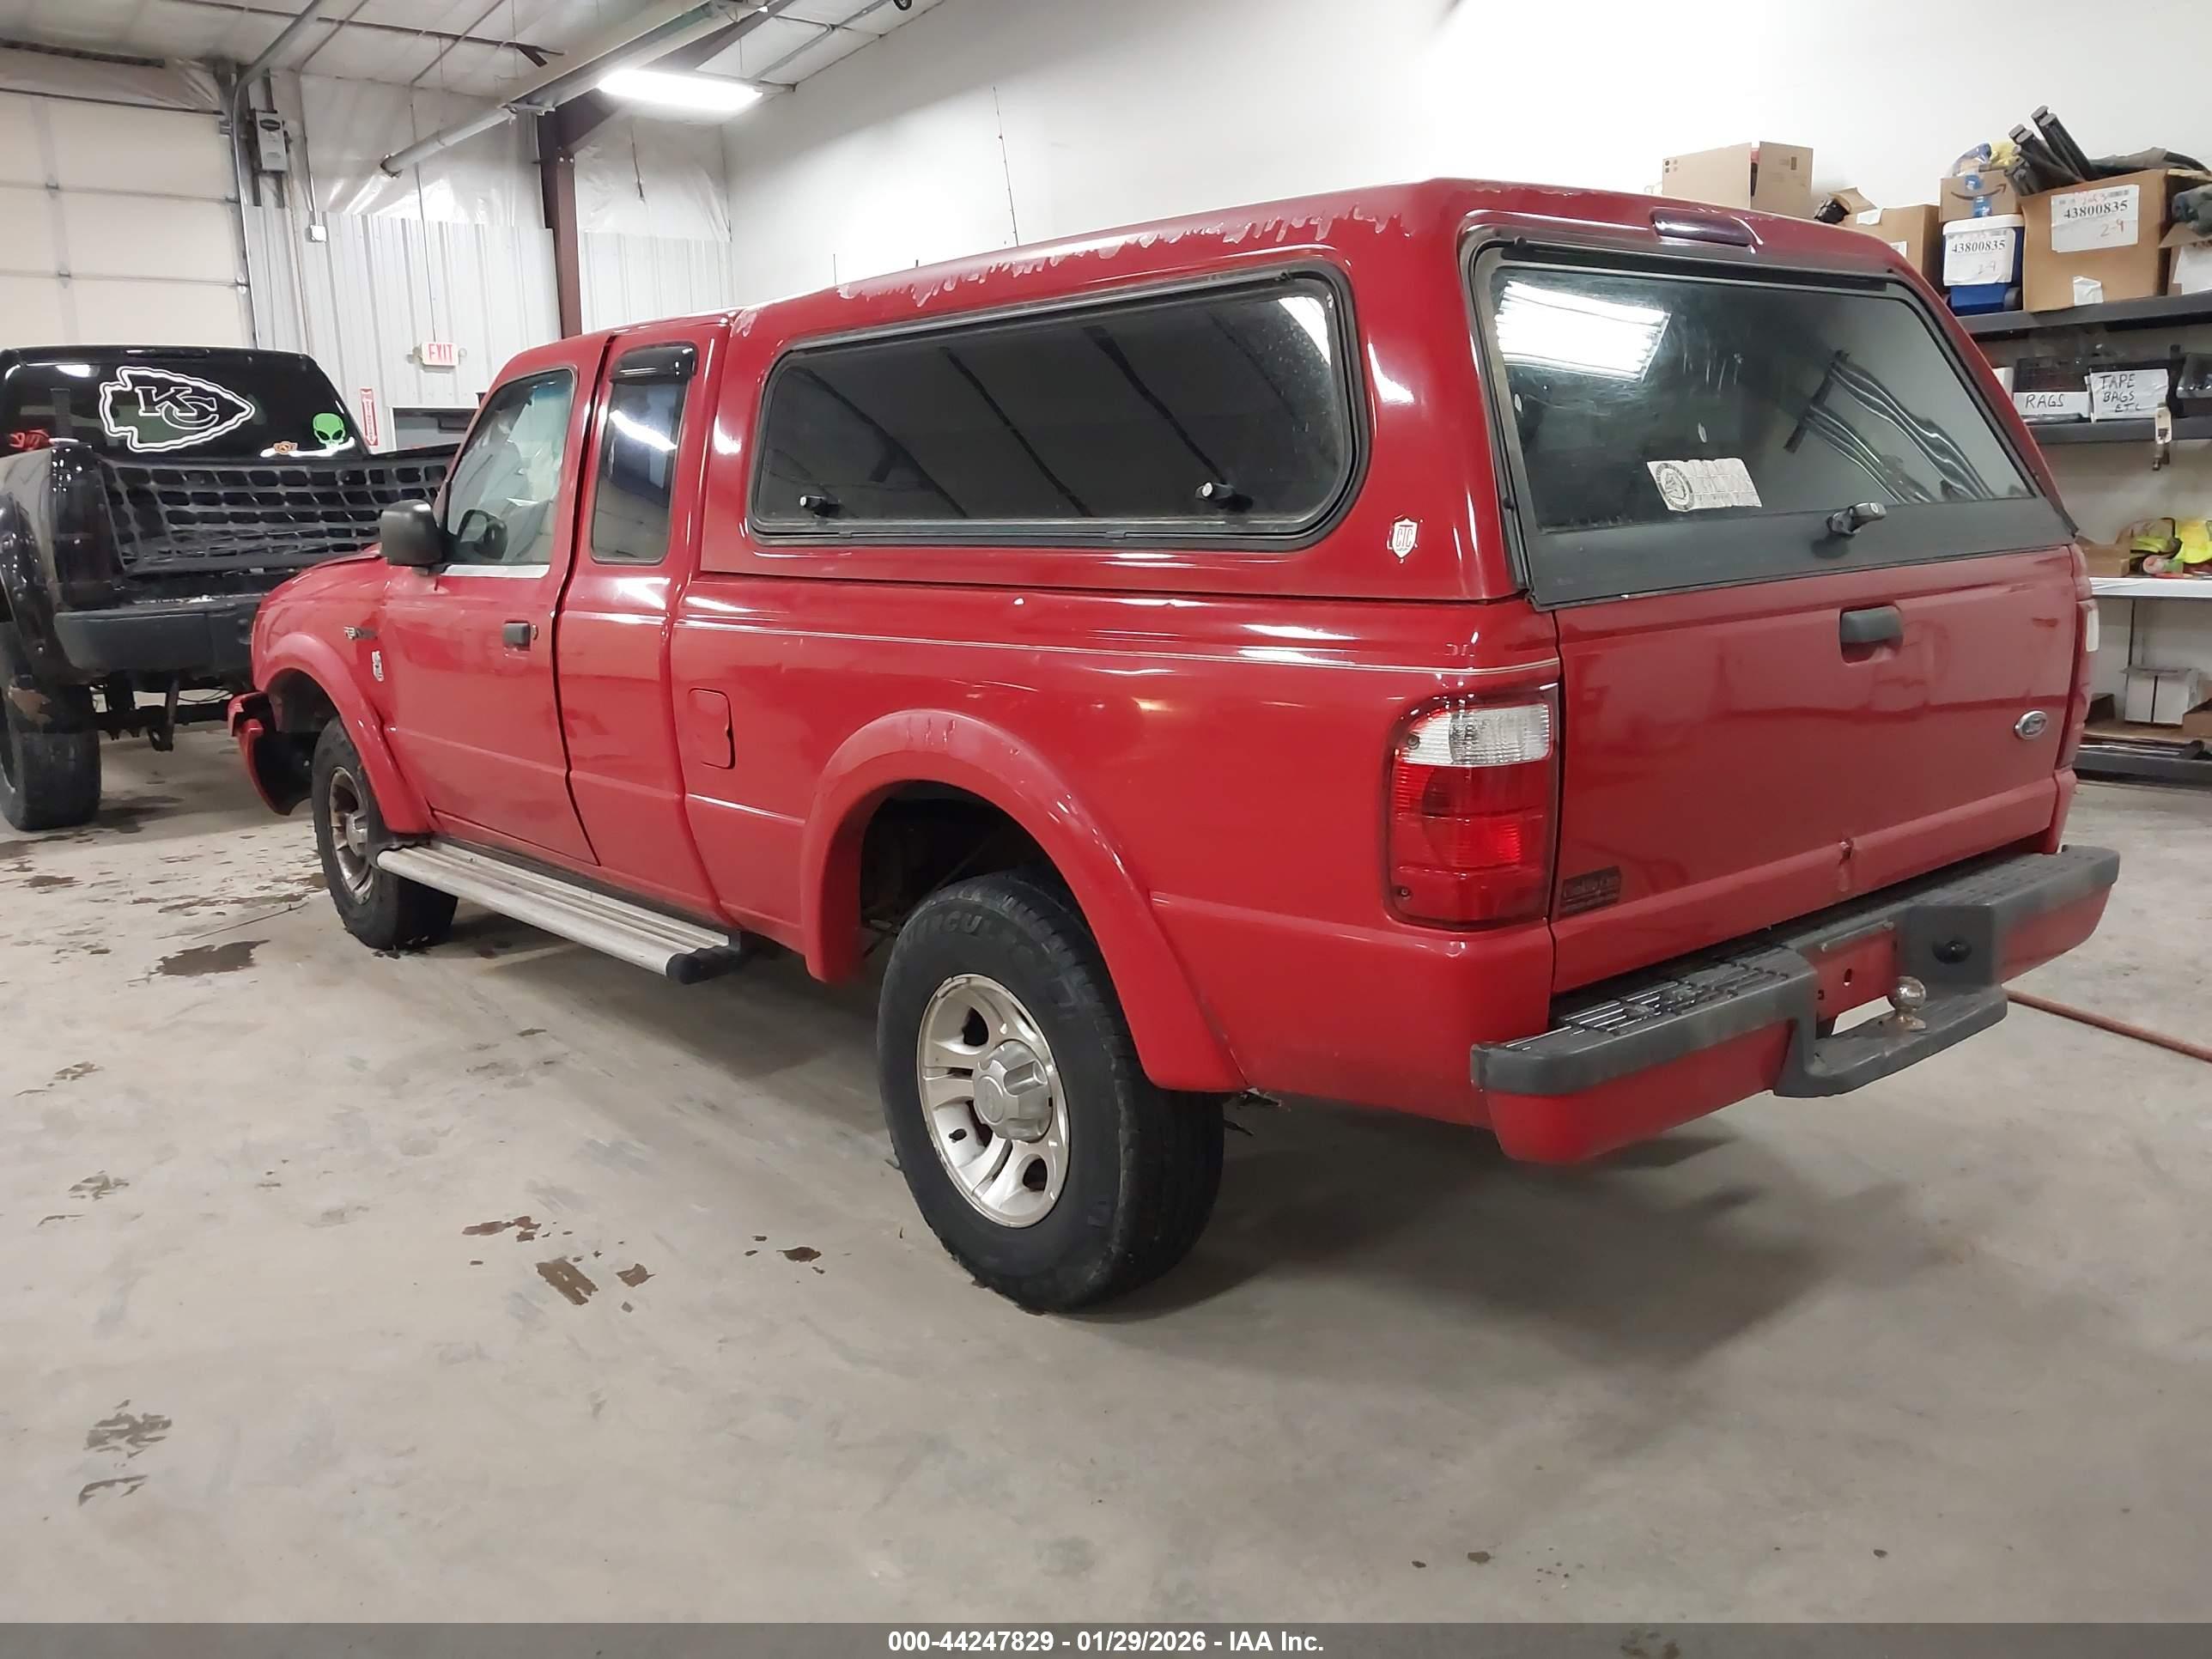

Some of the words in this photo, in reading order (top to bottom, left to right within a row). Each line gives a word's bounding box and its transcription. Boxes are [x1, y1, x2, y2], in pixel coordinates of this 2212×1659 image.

[2063, 200, 2128, 218] 43800835
[1952, 240, 2006, 253] 43800835
[428, 343, 453, 363] EXIT
[2100, 374, 2136, 389] TAPE
[2025, 393, 2064, 410] RAGS
[2104, 391, 2136, 403] BAGS
